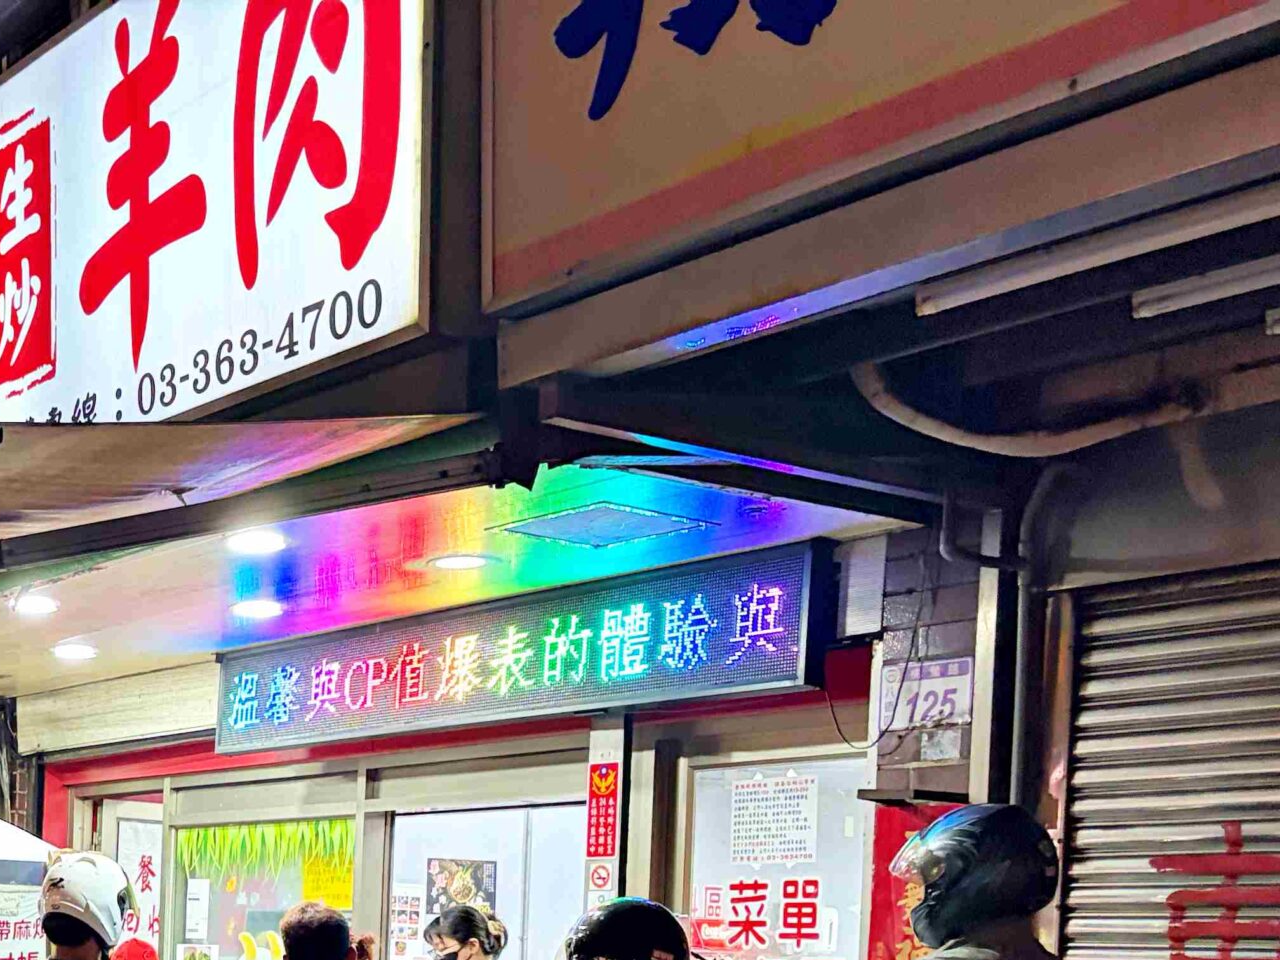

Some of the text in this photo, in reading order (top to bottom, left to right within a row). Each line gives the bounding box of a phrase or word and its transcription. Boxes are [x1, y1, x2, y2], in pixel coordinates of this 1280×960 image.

[136, 278, 384, 415] 03-363-4700
[906, 687, 958, 722] 125
[728, 879, 820, 948] 菜單
